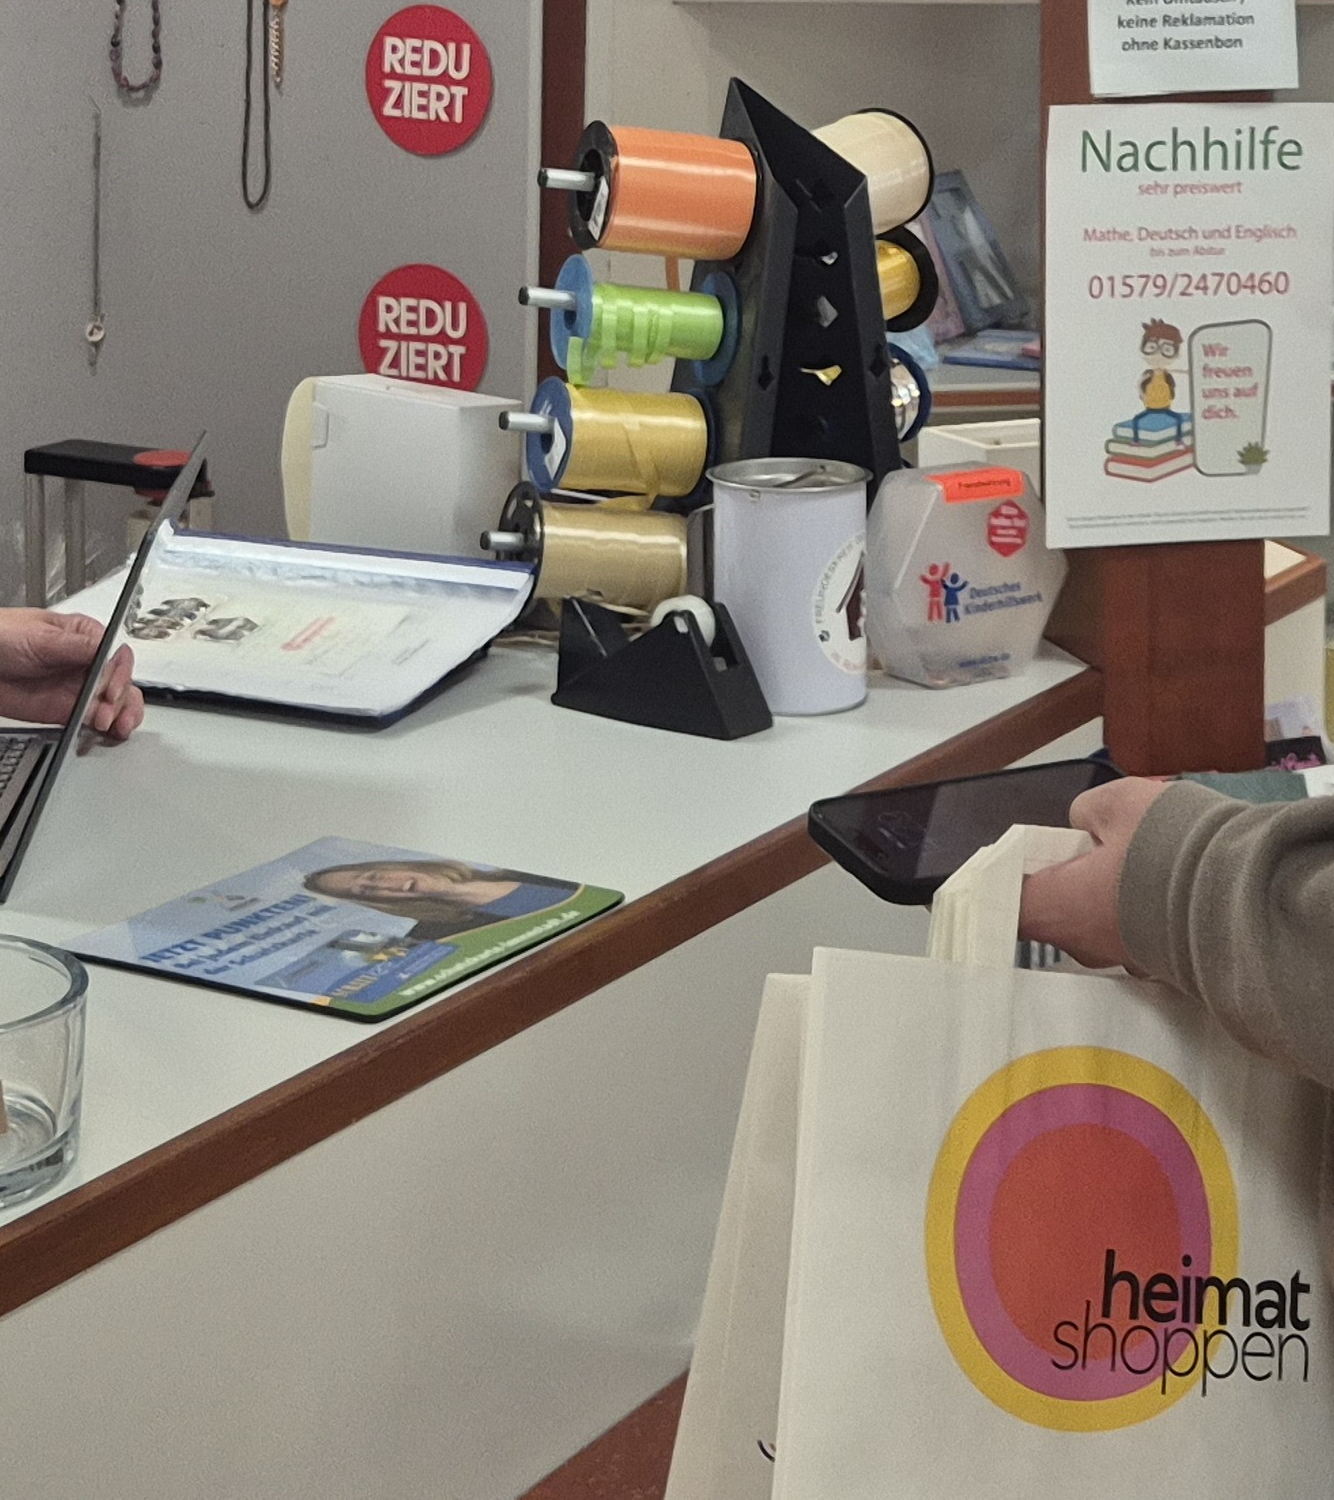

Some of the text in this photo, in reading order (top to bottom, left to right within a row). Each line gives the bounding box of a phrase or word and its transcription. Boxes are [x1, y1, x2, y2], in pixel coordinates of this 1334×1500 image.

[1117, 12, 1255, 28] keine Reklamation
[1121, 35, 1243, 51] ohne Kassenbon
[382, 36, 471, 80] REDU
[382, 80, 469, 123] ZIERT
[1080, 125, 1303, 173] Nachhilfe
[1138, 180, 1244, 197] sehr preiswert
[1082, 224, 1297, 243] Mathe, Deutsch und Englisch
[1088, 271, 1290, 299] 01579/2470460
[378, 296, 467, 338] REDU
[378, 339, 466, 381] ZIERT
[1202, 342, 1229, 358] Wir
[1202, 364, 1254, 379] freuen
[1202, 381, 1259, 398] uns auf
[1101, 1248, 1311, 1331] heimat
[1051, 1299, 1310, 1398] shoppen
